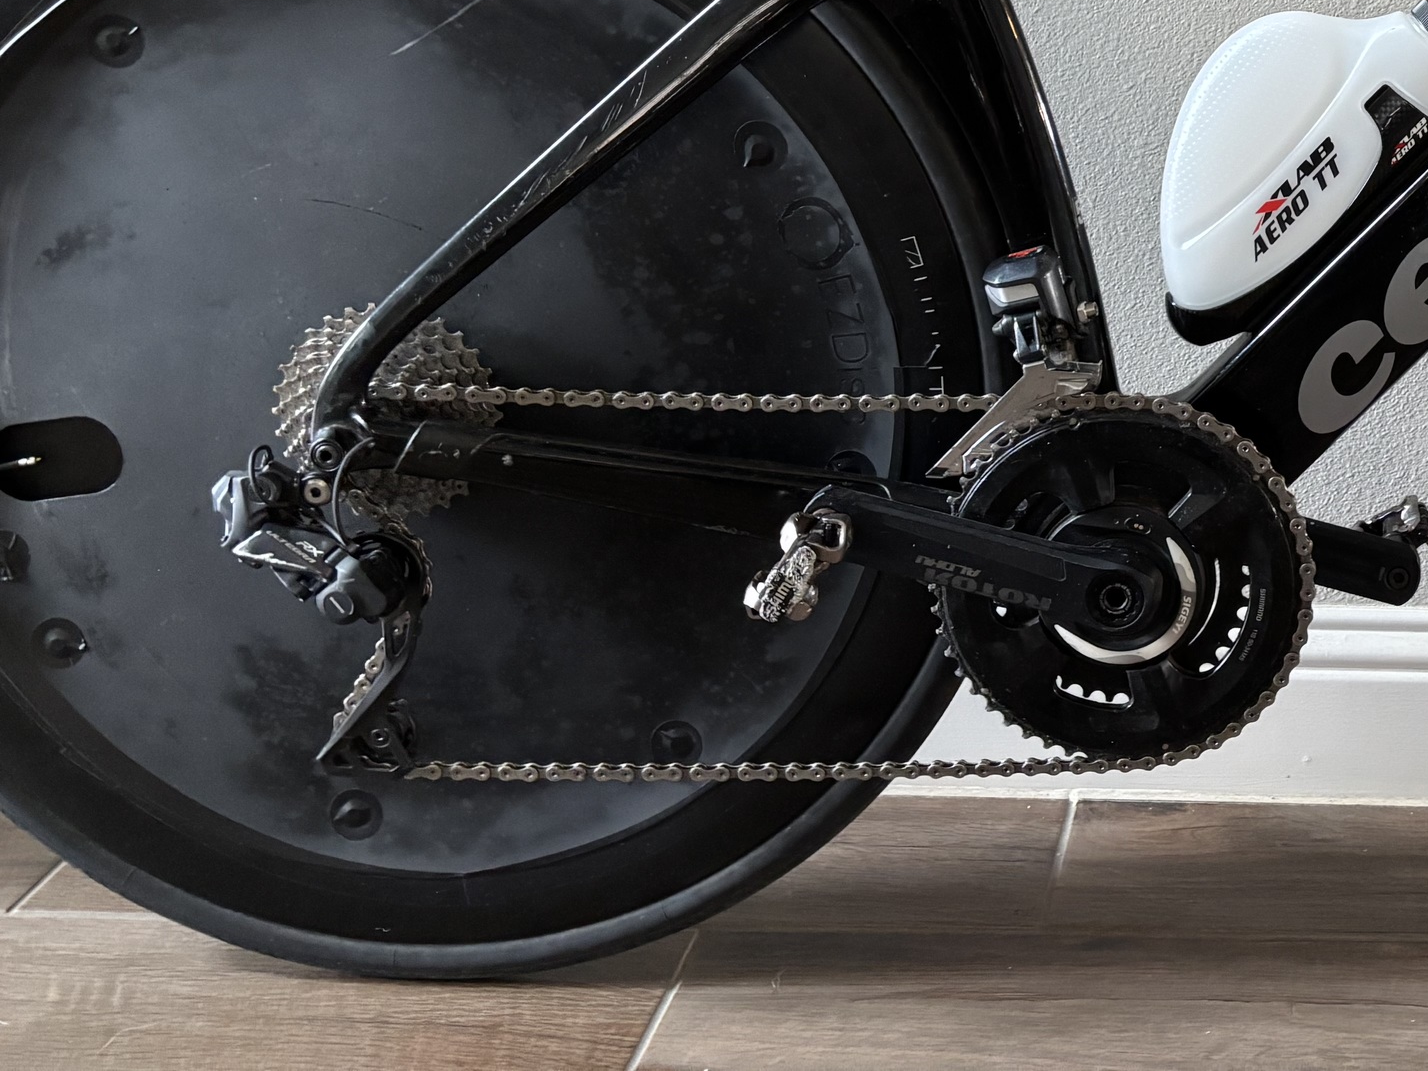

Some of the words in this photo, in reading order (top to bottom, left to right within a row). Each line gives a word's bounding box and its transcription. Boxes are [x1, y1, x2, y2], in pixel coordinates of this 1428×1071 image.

[1417, 123, 1428, 139] TT
[1254, 189, 1310, 263] AERO
[1312, 153, 1340, 191] TT
